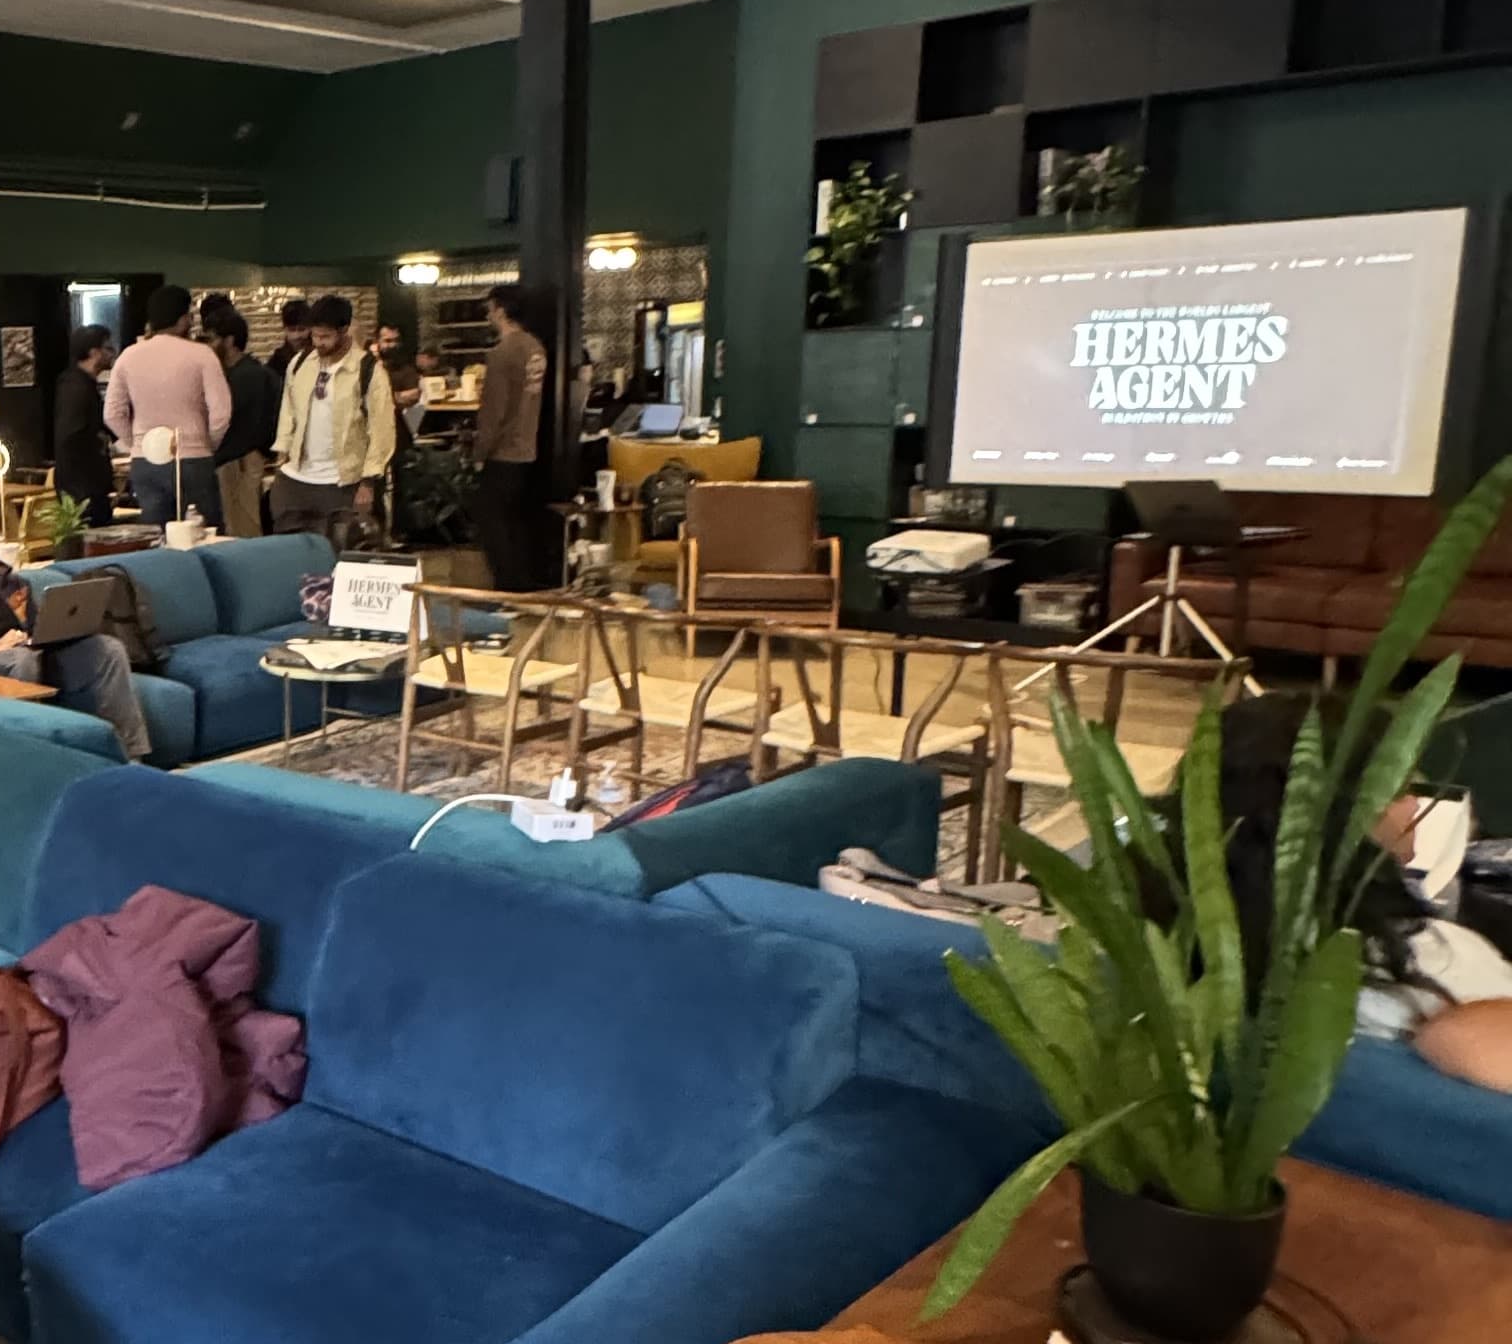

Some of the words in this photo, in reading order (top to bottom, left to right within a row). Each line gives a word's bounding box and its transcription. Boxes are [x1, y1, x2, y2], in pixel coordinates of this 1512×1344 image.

[1069, 315, 1289, 367] HERMES
[1088, 364, 1256, 409] AGENT
[348, 578, 402, 596] HERMES
[352, 594, 394, 611] AGENT
